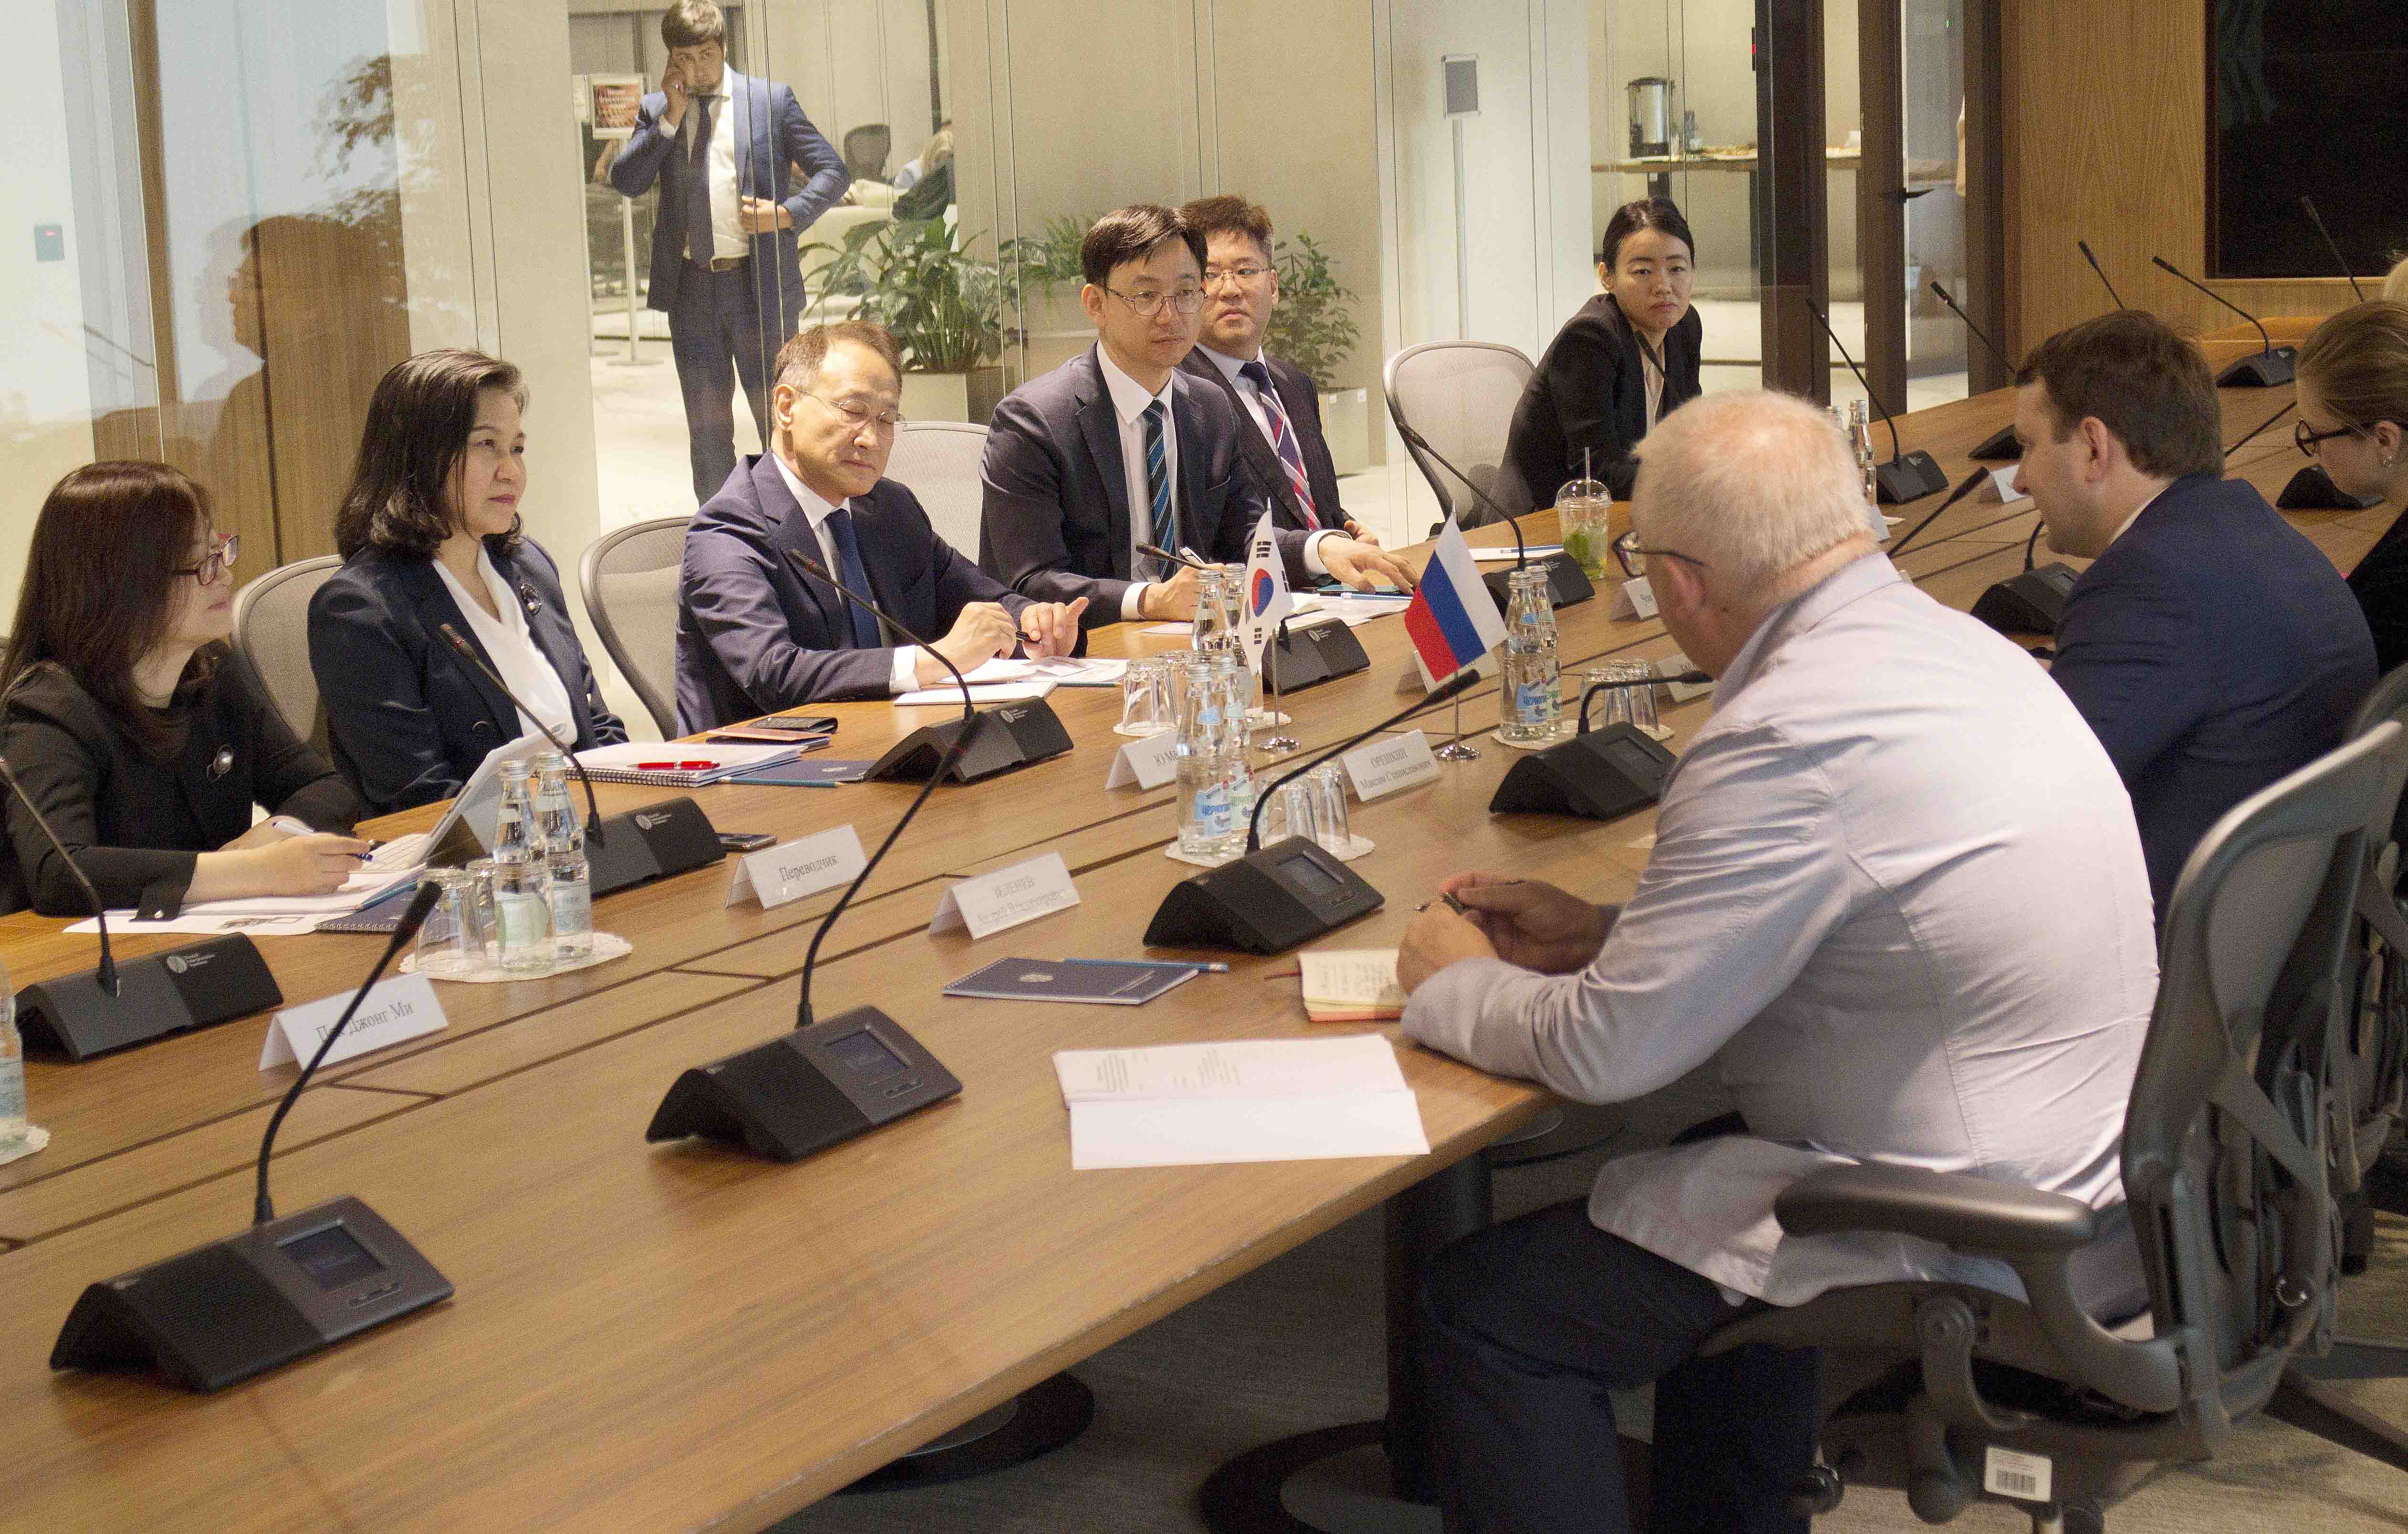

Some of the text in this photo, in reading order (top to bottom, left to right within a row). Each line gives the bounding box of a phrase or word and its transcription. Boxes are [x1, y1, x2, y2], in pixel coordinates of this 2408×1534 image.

[779, 855, 839, 881] Переводчик
[347, 1010, 389, 1035] Джонг
[389, 1002, 415, 1019] Ми
